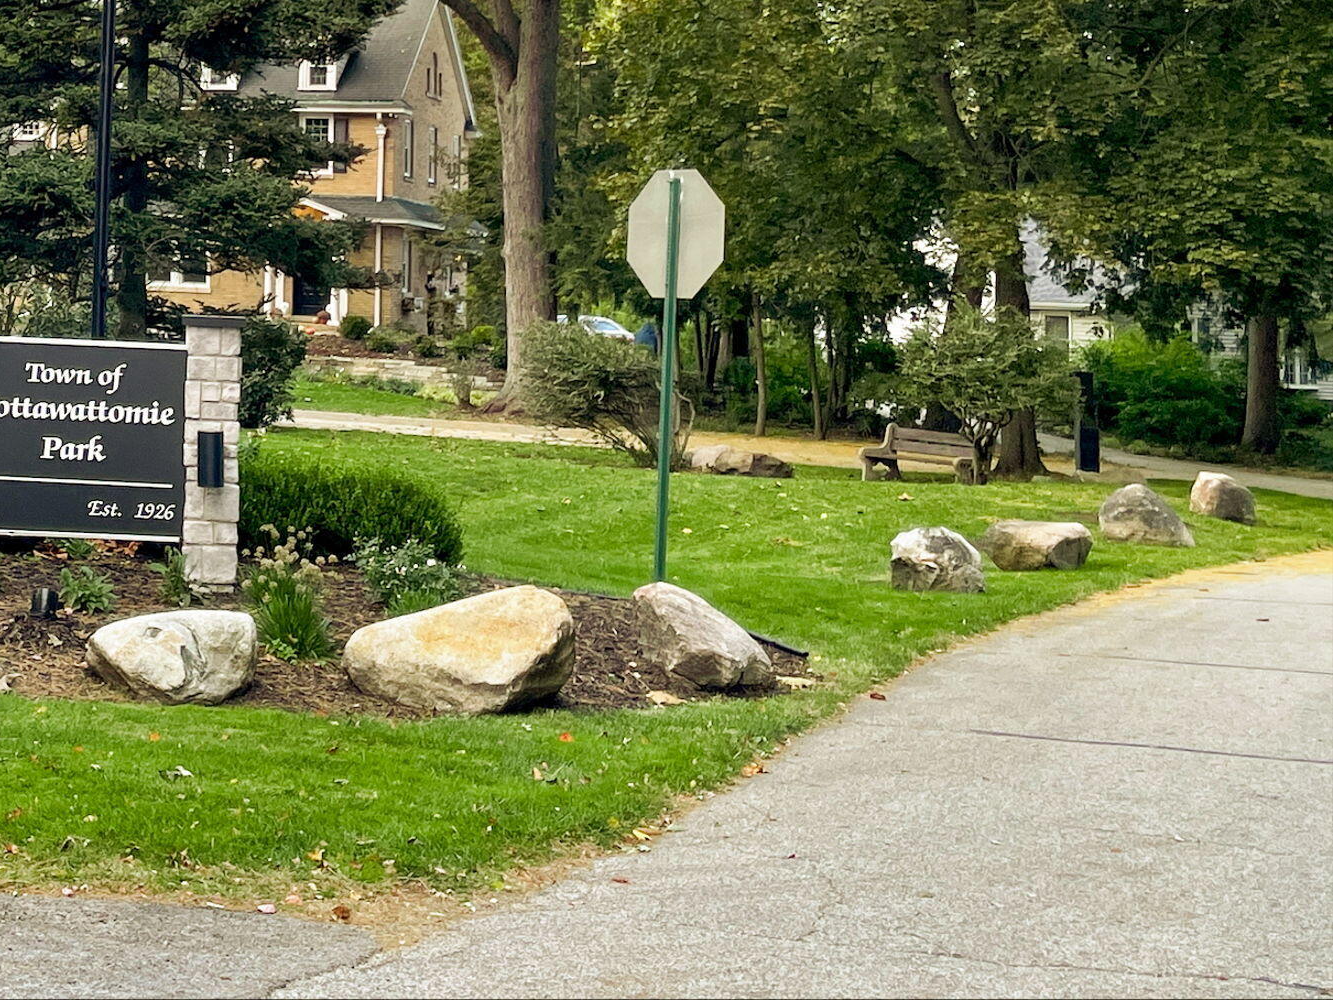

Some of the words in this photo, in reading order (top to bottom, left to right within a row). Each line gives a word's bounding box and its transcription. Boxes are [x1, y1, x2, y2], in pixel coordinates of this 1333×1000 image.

[25, 362, 93, 385] Town
[97, 363, 127, 395] of
[40, 435, 106, 462] Park
[87, 500, 122, 518] Est.
[133, 502, 176, 520] 1926
